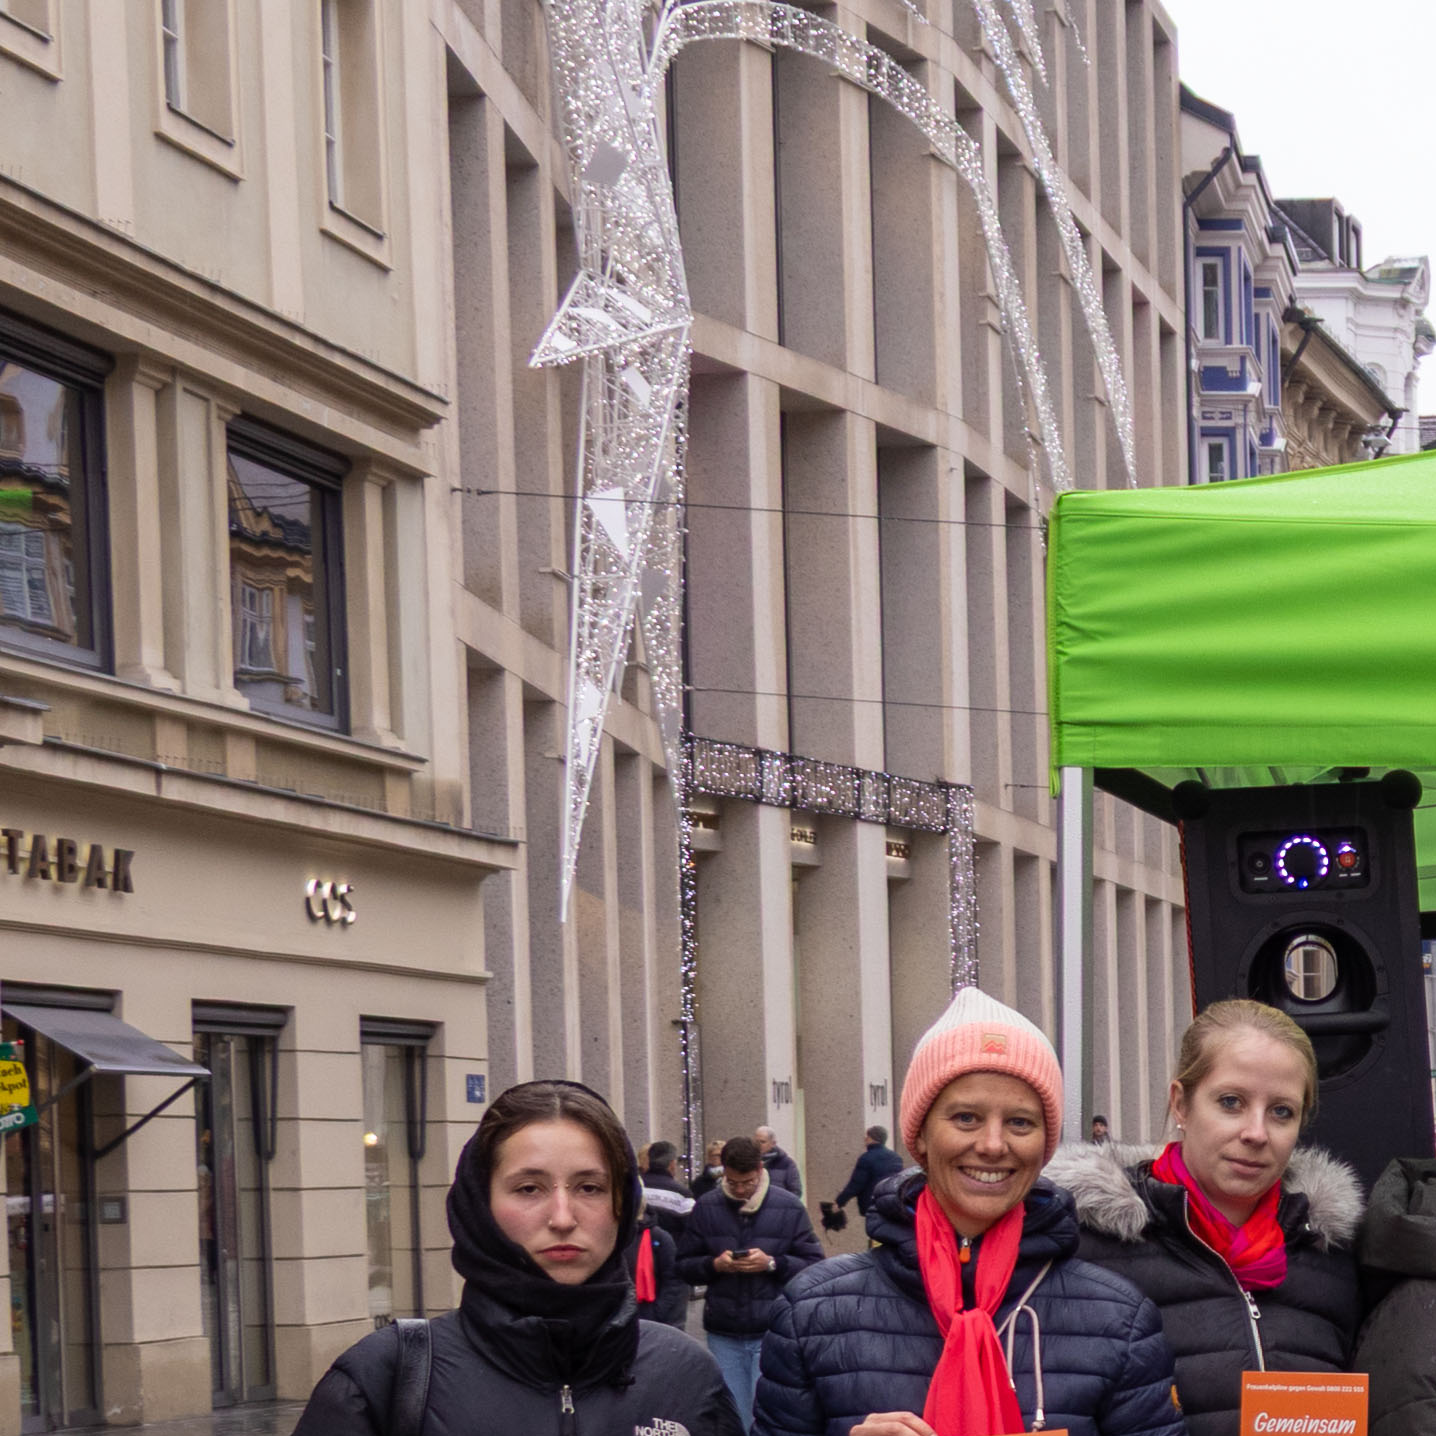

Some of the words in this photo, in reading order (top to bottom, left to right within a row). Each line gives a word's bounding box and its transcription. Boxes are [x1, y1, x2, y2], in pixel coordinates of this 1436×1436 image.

[2, 828, 135, 894] TABAK
[772, 1075, 792, 1111] tyrol
[869, 1078, 888, 1113] tyrol
[652, 1417, 678, 1432] THE
[1253, 1411, 1356, 1433] Gemeinsam
